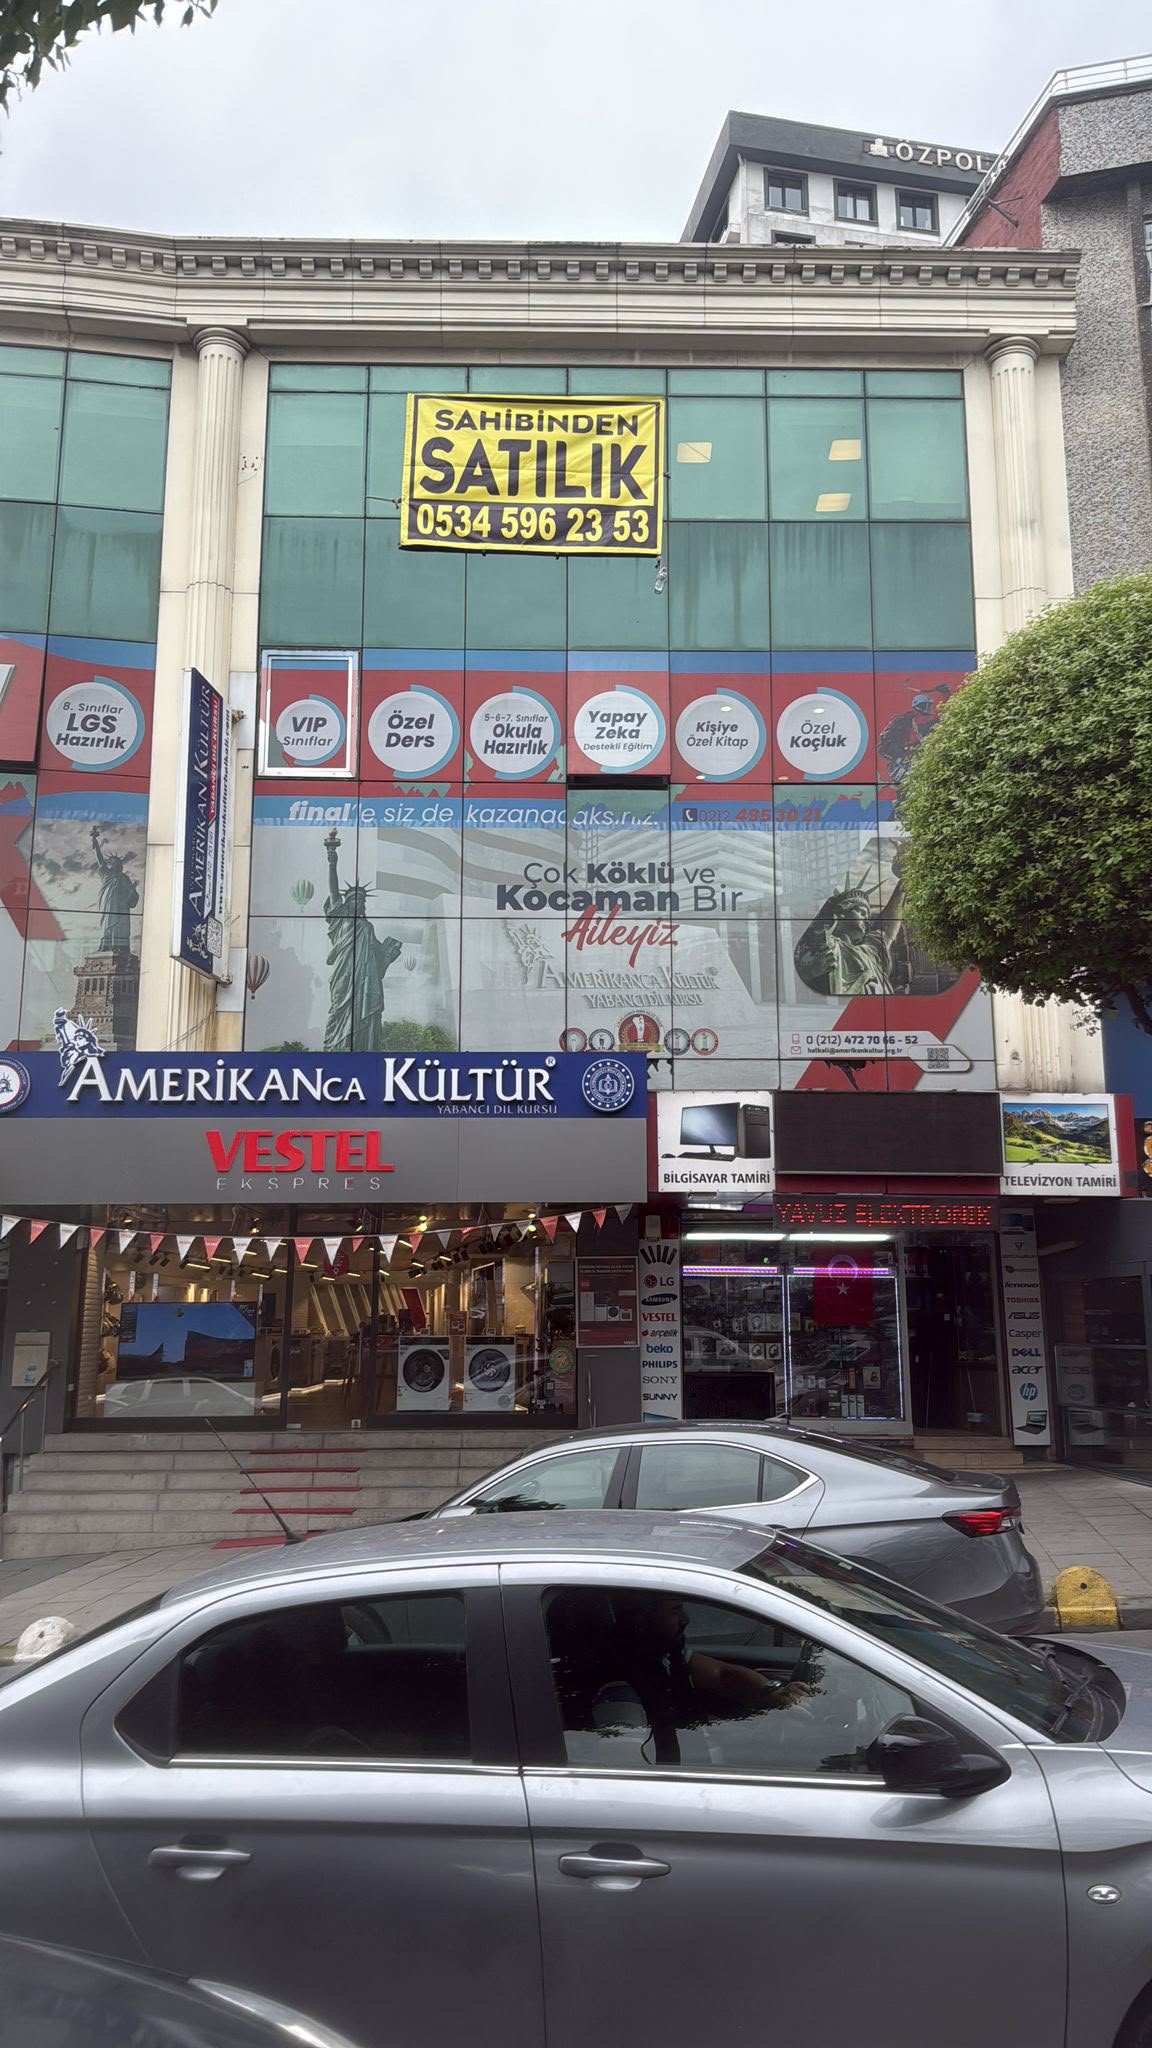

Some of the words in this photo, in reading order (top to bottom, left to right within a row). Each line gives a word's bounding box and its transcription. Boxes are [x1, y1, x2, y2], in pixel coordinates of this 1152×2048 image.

[435, 408, 639, 437] SAHİBİNDEN
[419, 436, 649, 500] SATILIK
[416, 503, 491, 538] 0534
[501, 506, 556, 540] 596
[566, 508, 602, 543] 23
[613, 509, 650, 543] 53
[63, 701, 74, 712] 8.
[78, 702, 124, 715] Sınıflar
[66, 713, 118, 734] LGS
[291, 716, 328, 733] VIP
[387, 709, 435, 730] Özel
[484, 713, 514, 723] 5-6-7.
[516, 713, 549, 723] Sınıflar
[588, 710, 648, 727] Yapay
[492, 723, 542, 739] Okula
[595, 726, 640, 740] Zeka
[696, 721, 738, 734] Kişiye
[800, 719, 835, 735] Özel
[56, 733, 127, 749] Hazırlık
[283, 735, 333, 747] Sınıflar
[385, 732, 436, 749] Ders
[483, 739, 549, 755] Hazırlık
[583, 742, 621, 751] Destekli
[623, 742, 653, 752] Eğitim
[687, 733, 714, 747] Özel
[715, 735, 749, 750] Kitap
[790, 734, 847, 752] Koçluk
[383, 804, 415, 823] siz
[422, 803, 454, 823] de
[803, 807, 821, 822] 21
[523, 862, 579, 889] Çok
[587, 861, 674, 885] Köklü
[684, 867, 716, 885] ve
[496, 884, 680, 912] Kocaman
[694, 884, 743, 912] Bir
[561, 904, 681, 969] Aileyiz
[806, 1035, 813, 1045] 0
[816, 1034, 841, 1047] (212)
[844, 1035, 865, 1045] 472
[867, 1035, 880, 1045] 70
[905, 1035, 918, 1045] 52
[437, 1104, 490, 1115] YABANCI
[517, 1104, 557, 1115] KURSU
[206, 1130, 396, 1173] VESTEL
[663, 1171, 728, 1184] BİLGİSAYAR
[730, 1171, 771, 1184] TAMİRİ
[1003, 1173, 1072, 1188] TELEVİZYON
[1077, 1174, 1117, 1188] TAMİRİ
[660, 1276, 675, 1287] LG
[642, 1312, 677, 1322] VESTEL
[650, 1328, 679, 1338] arçelik
[1008, 1328, 1042, 1340] Casper
[646, 1344, 674, 1354] beko
[1011, 1347, 1041, 1357] DELL
[642, 1360, 678, 1369] PHILIPS
[1012, 1365, 1044, 1375] acer
[642, 1376, 678, 1384] SONY
[642, 1393, 678, 1401] SUNNY
[1022, 1383, 1038, 1400] hp
